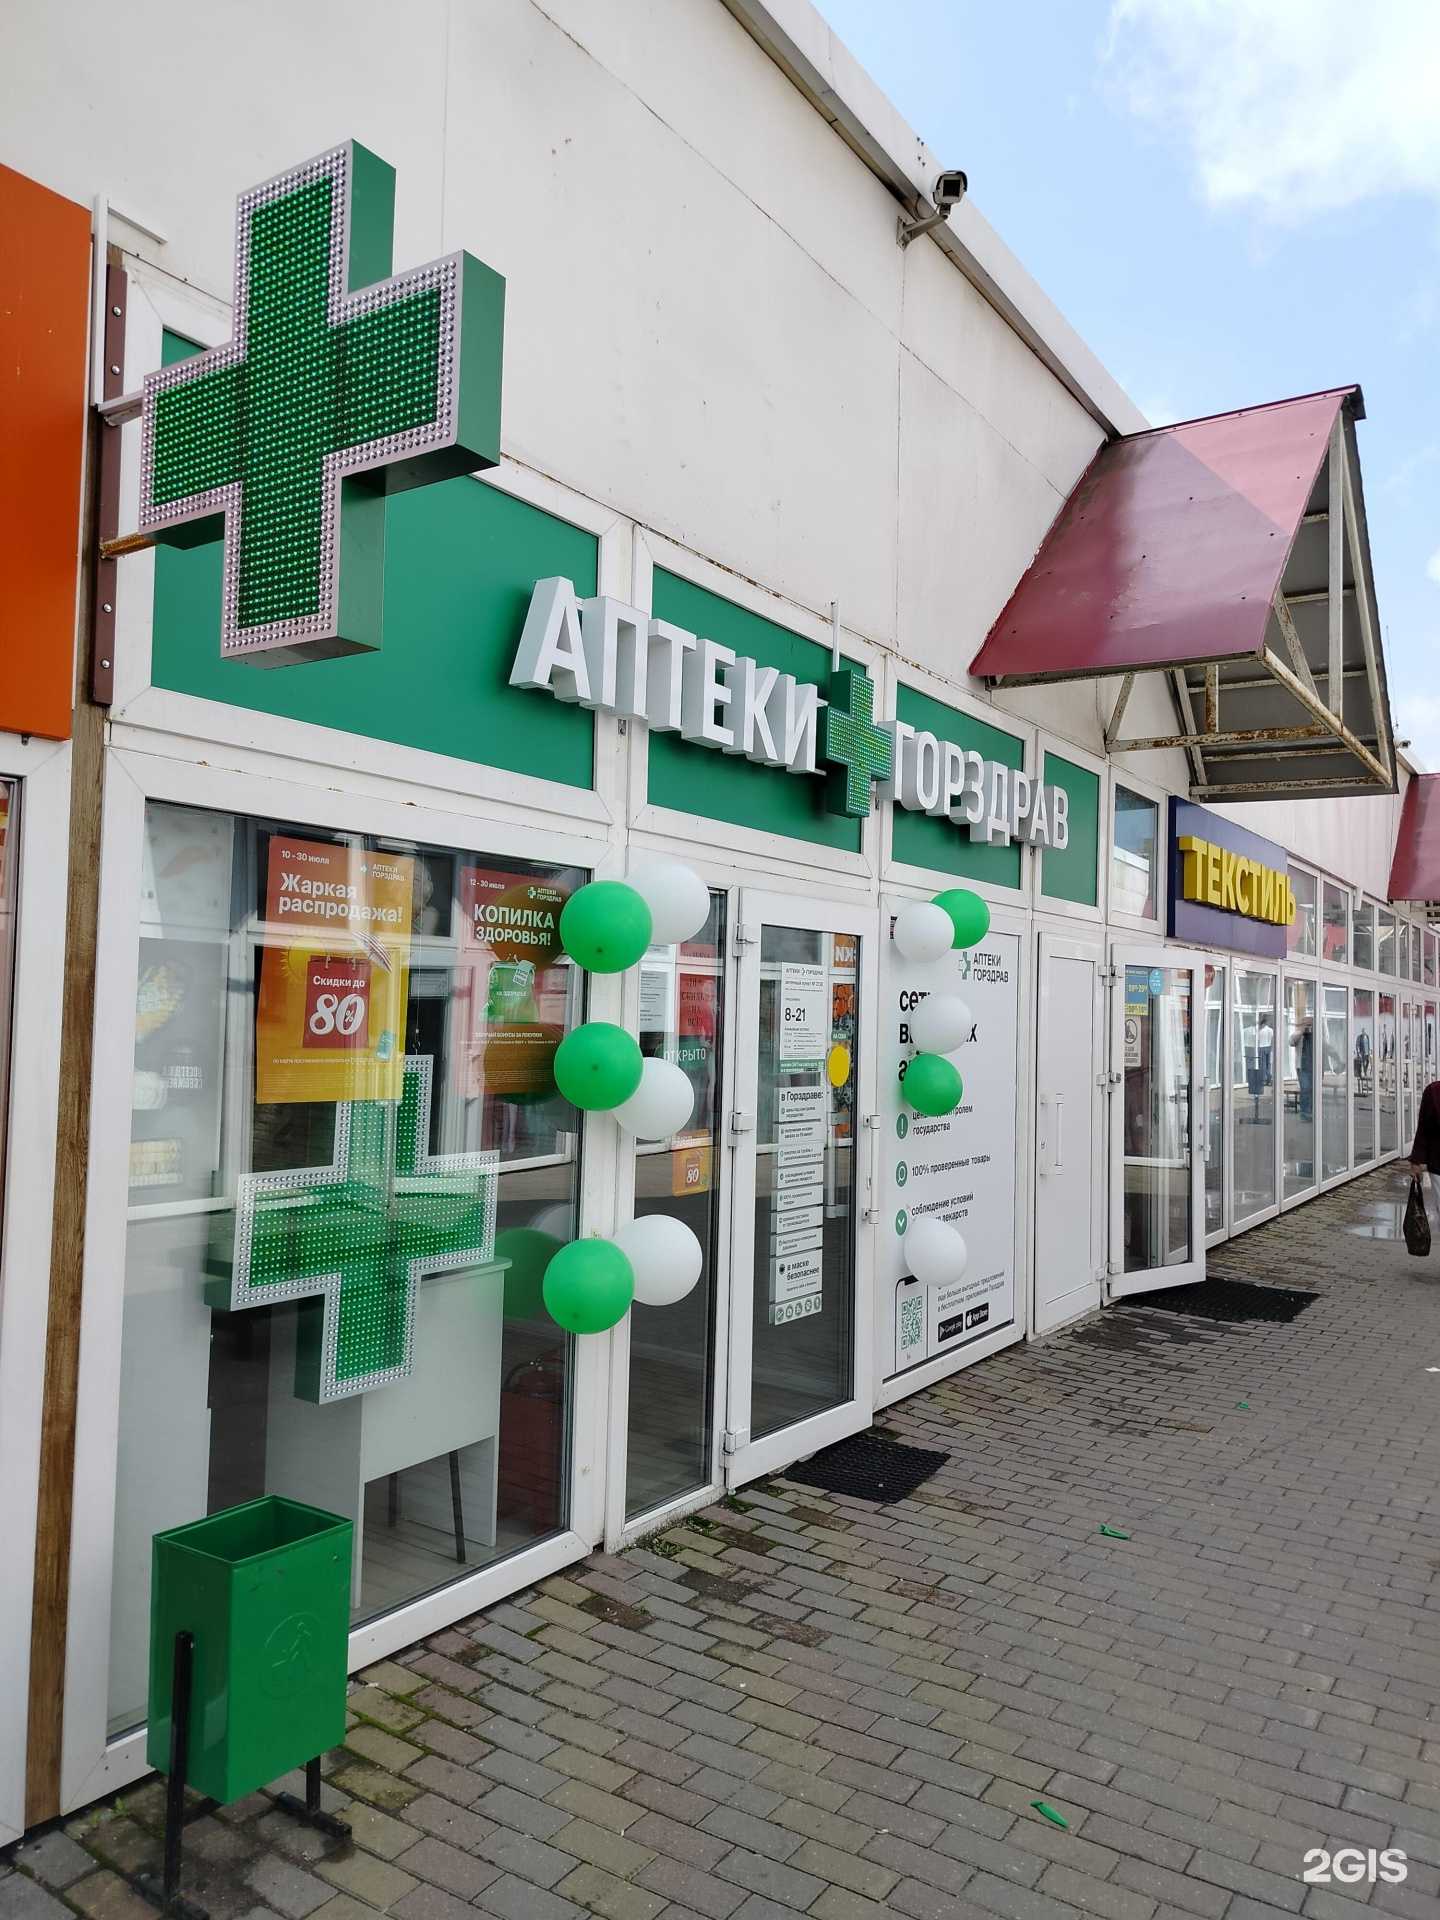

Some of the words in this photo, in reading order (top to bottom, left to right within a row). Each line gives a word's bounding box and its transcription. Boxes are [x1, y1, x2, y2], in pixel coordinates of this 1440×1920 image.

[509, 576, 818, 774] АПТЕКИ
[877, 720, 1069, 849] ГОРЗДРАВ
[308, 855, 330, 865] июля
[372, 863, 398, 873] АПТЕКИ
[280, 872, 357, 899] Жаркая
[489, 881, 505, 890] июля
[1179, 836, 1296, 926] ТЕКСТИЛЬ
[278, 896, 402, 923] распродажа!
[474, 903, 555, 929] КОПИЛКА
[476, 926, 551, 946] ЗДОРОВЬЯ!
[973, 952, 1001, 967] АПТЕКИ
[313, 975, 351, 987] Скидки
[353, 979, 365, 989] до
[973, 968, 1009, 983] ГОРЗДРАВ
[664, 1047, 706, 1063] ОТКРЫТО
[781, 1093, 786, 1101] в
[787, 1091, 824, 1103] Горздраве:
[912, 1121, 951, 1136] государства
[912, 1164, 930, 1177] 100%
[930, 1157, 970, 1174] проверенные
[971, 1153, 991, 1165] товары
[911, 1199, 950, 1217] соблюдение
[950, 1191, 974, 1208] условий
